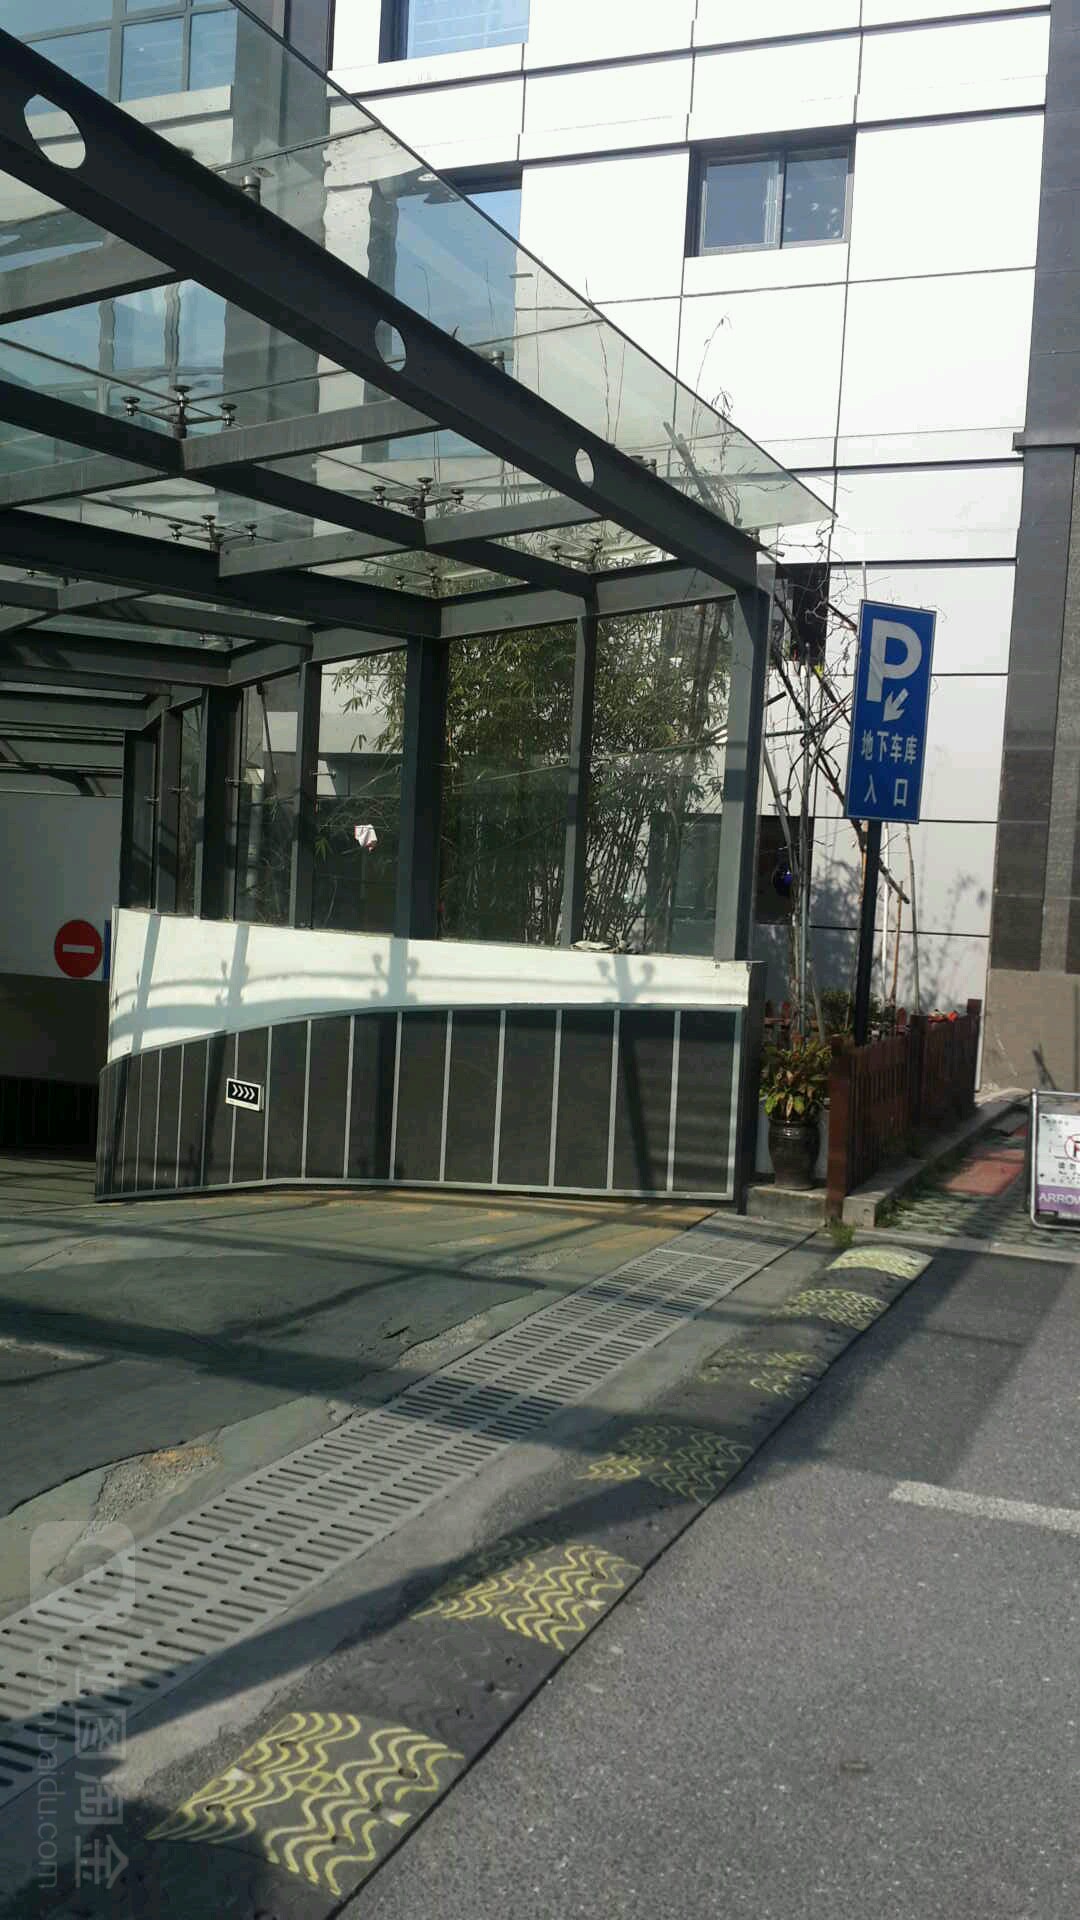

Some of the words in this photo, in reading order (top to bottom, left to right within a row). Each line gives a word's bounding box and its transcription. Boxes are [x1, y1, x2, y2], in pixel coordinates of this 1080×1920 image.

[866, 618, 922, 702] P
[861, 729, 918, 764] 地下车库
[864, 774, 908, 807] 入口
